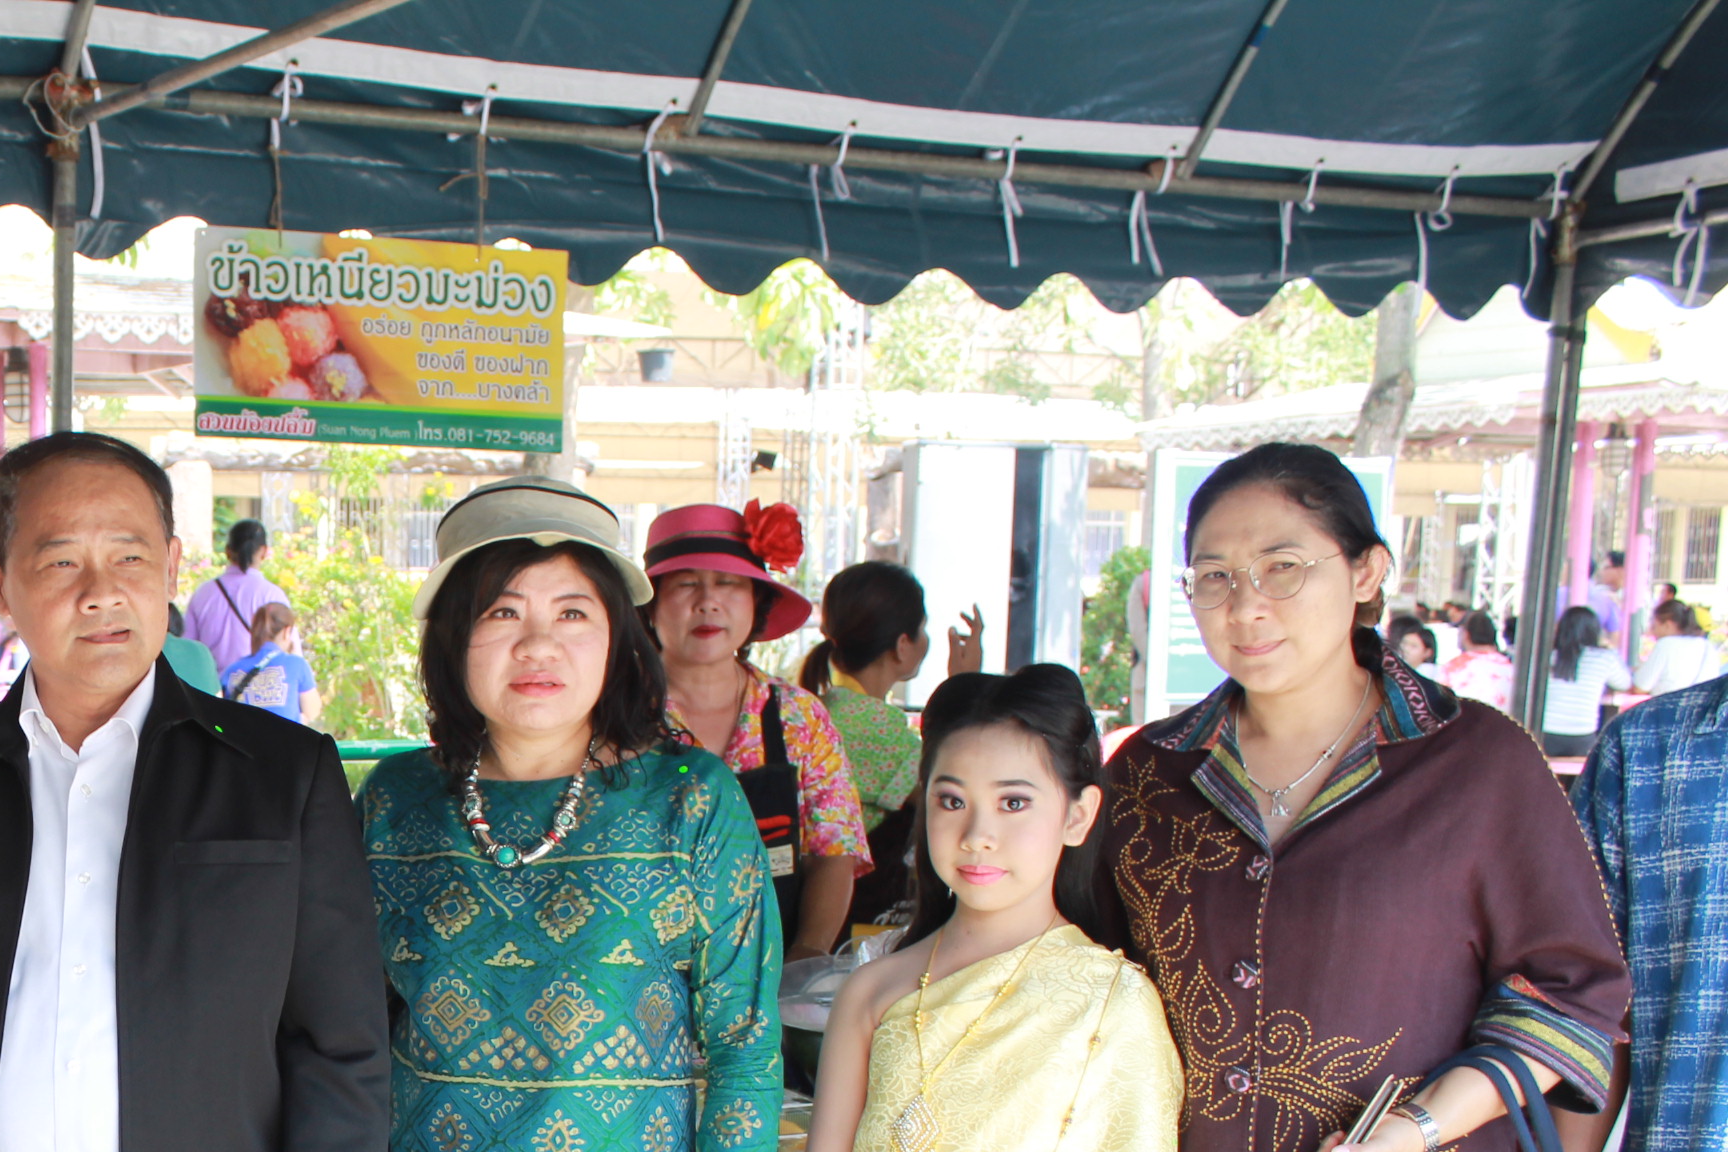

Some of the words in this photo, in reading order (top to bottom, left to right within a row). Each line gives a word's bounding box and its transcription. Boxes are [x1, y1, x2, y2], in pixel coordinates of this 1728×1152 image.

[210, 242, 555, 313] ข้าวเหนียวมะม่วง
[362, 315, 411, 335] อร่อย
[421, 320, 549, 345] ถูกหลักอนามัย
[418, 350, 465, 371] ของดี
[475, 353, 548, 376] ของฝาก
